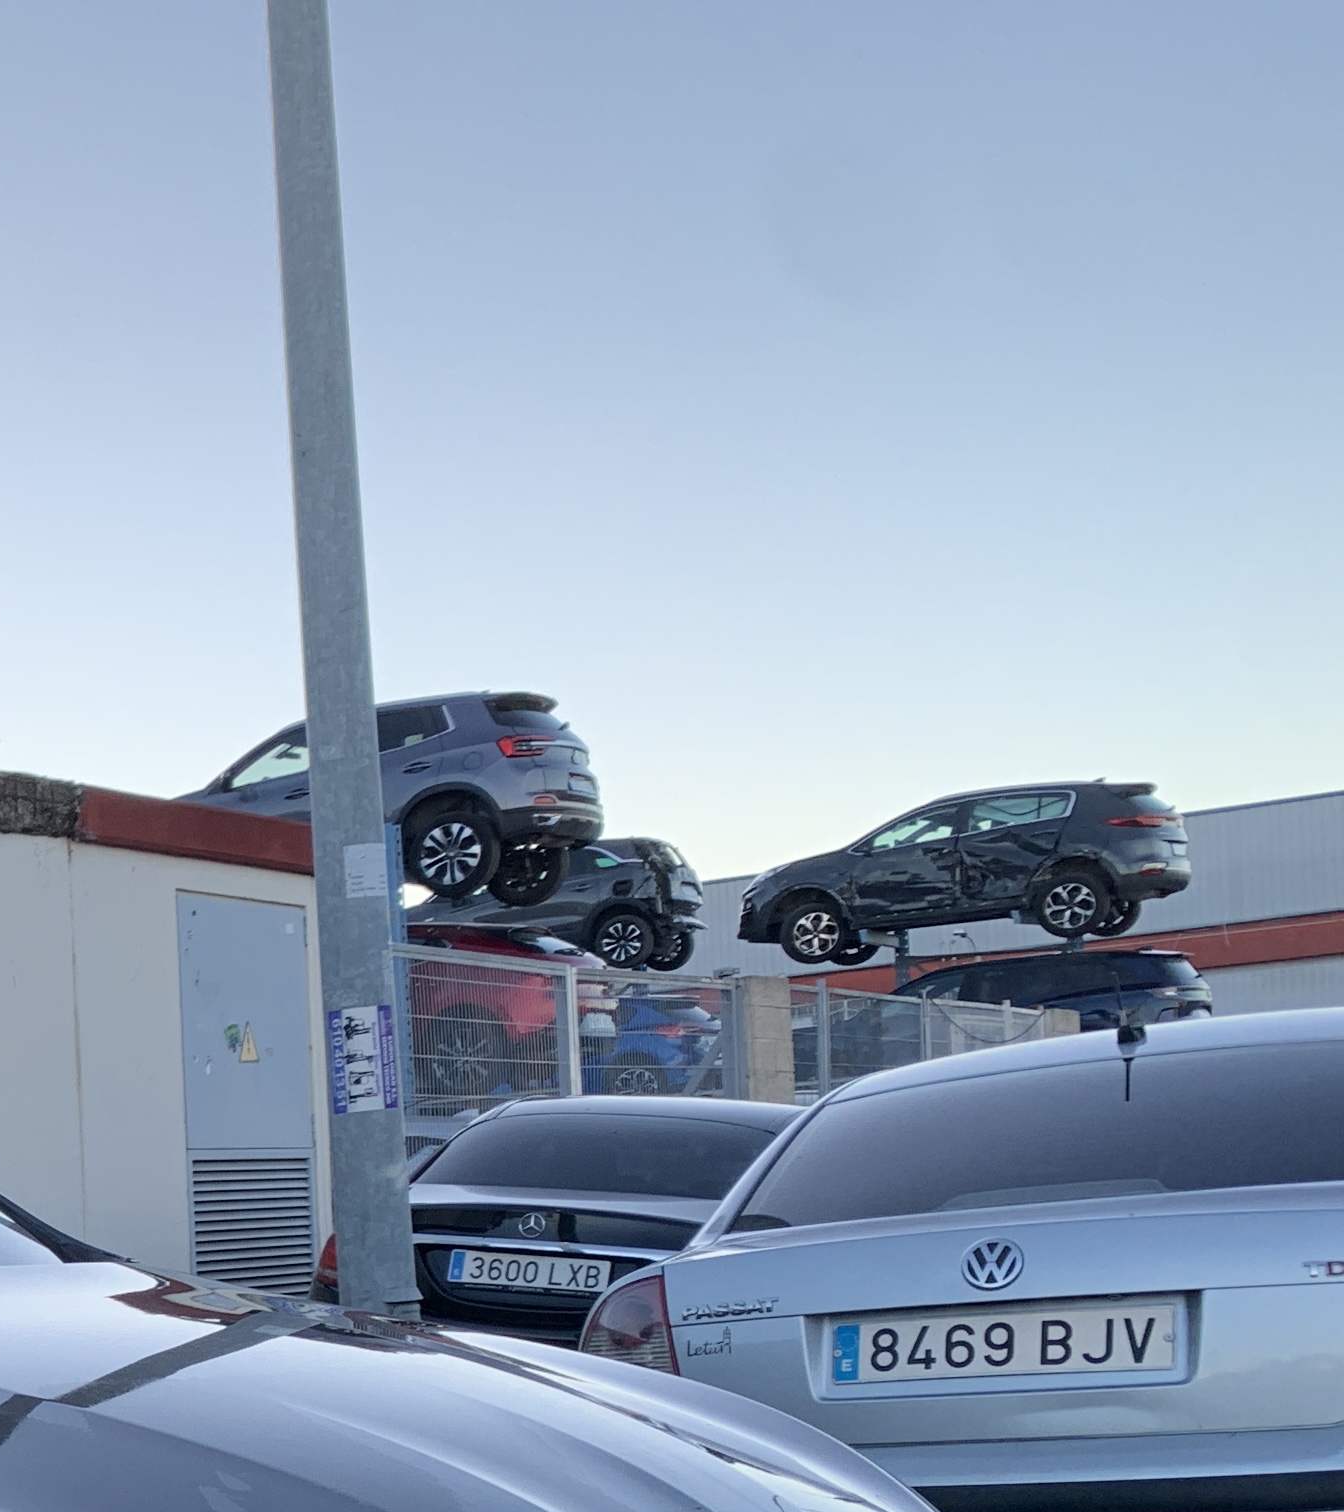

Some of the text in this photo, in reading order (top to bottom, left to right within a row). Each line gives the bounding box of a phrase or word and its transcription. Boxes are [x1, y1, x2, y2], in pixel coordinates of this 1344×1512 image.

[469, 1257, 601, 1289] 3600 LXB
[681, 1297, 779, 1321] PASSAT
[870, 1317, 1157, 1373] 8469 BJV
[840, 1359, 854, 1373] E
